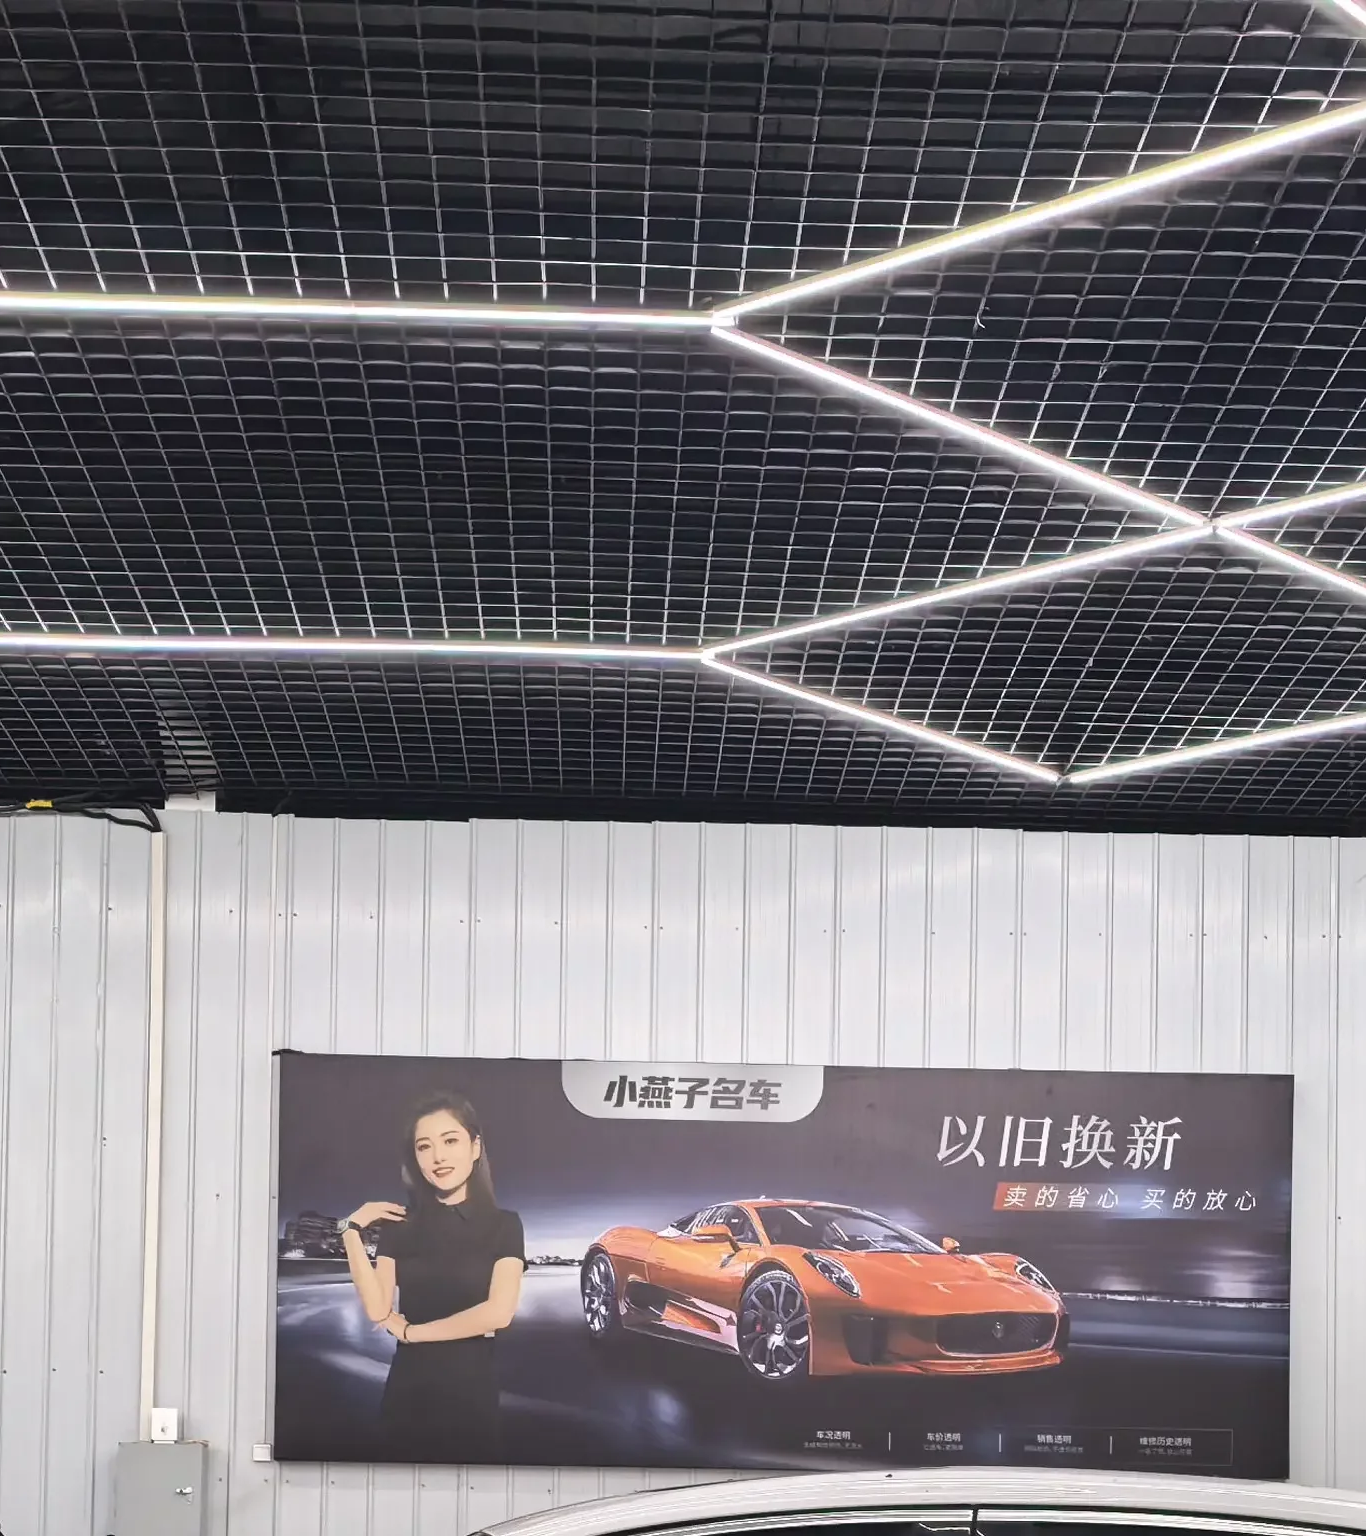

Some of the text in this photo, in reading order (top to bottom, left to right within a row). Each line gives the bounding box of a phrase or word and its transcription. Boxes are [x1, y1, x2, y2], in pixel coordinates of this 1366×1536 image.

[603, 1075, 782, 1111] 小燕子名车
[937, 1114, 1186, 1171] 以旧换新
[1003, 1185, 1257, 1212] 卖的省心 买的放心
